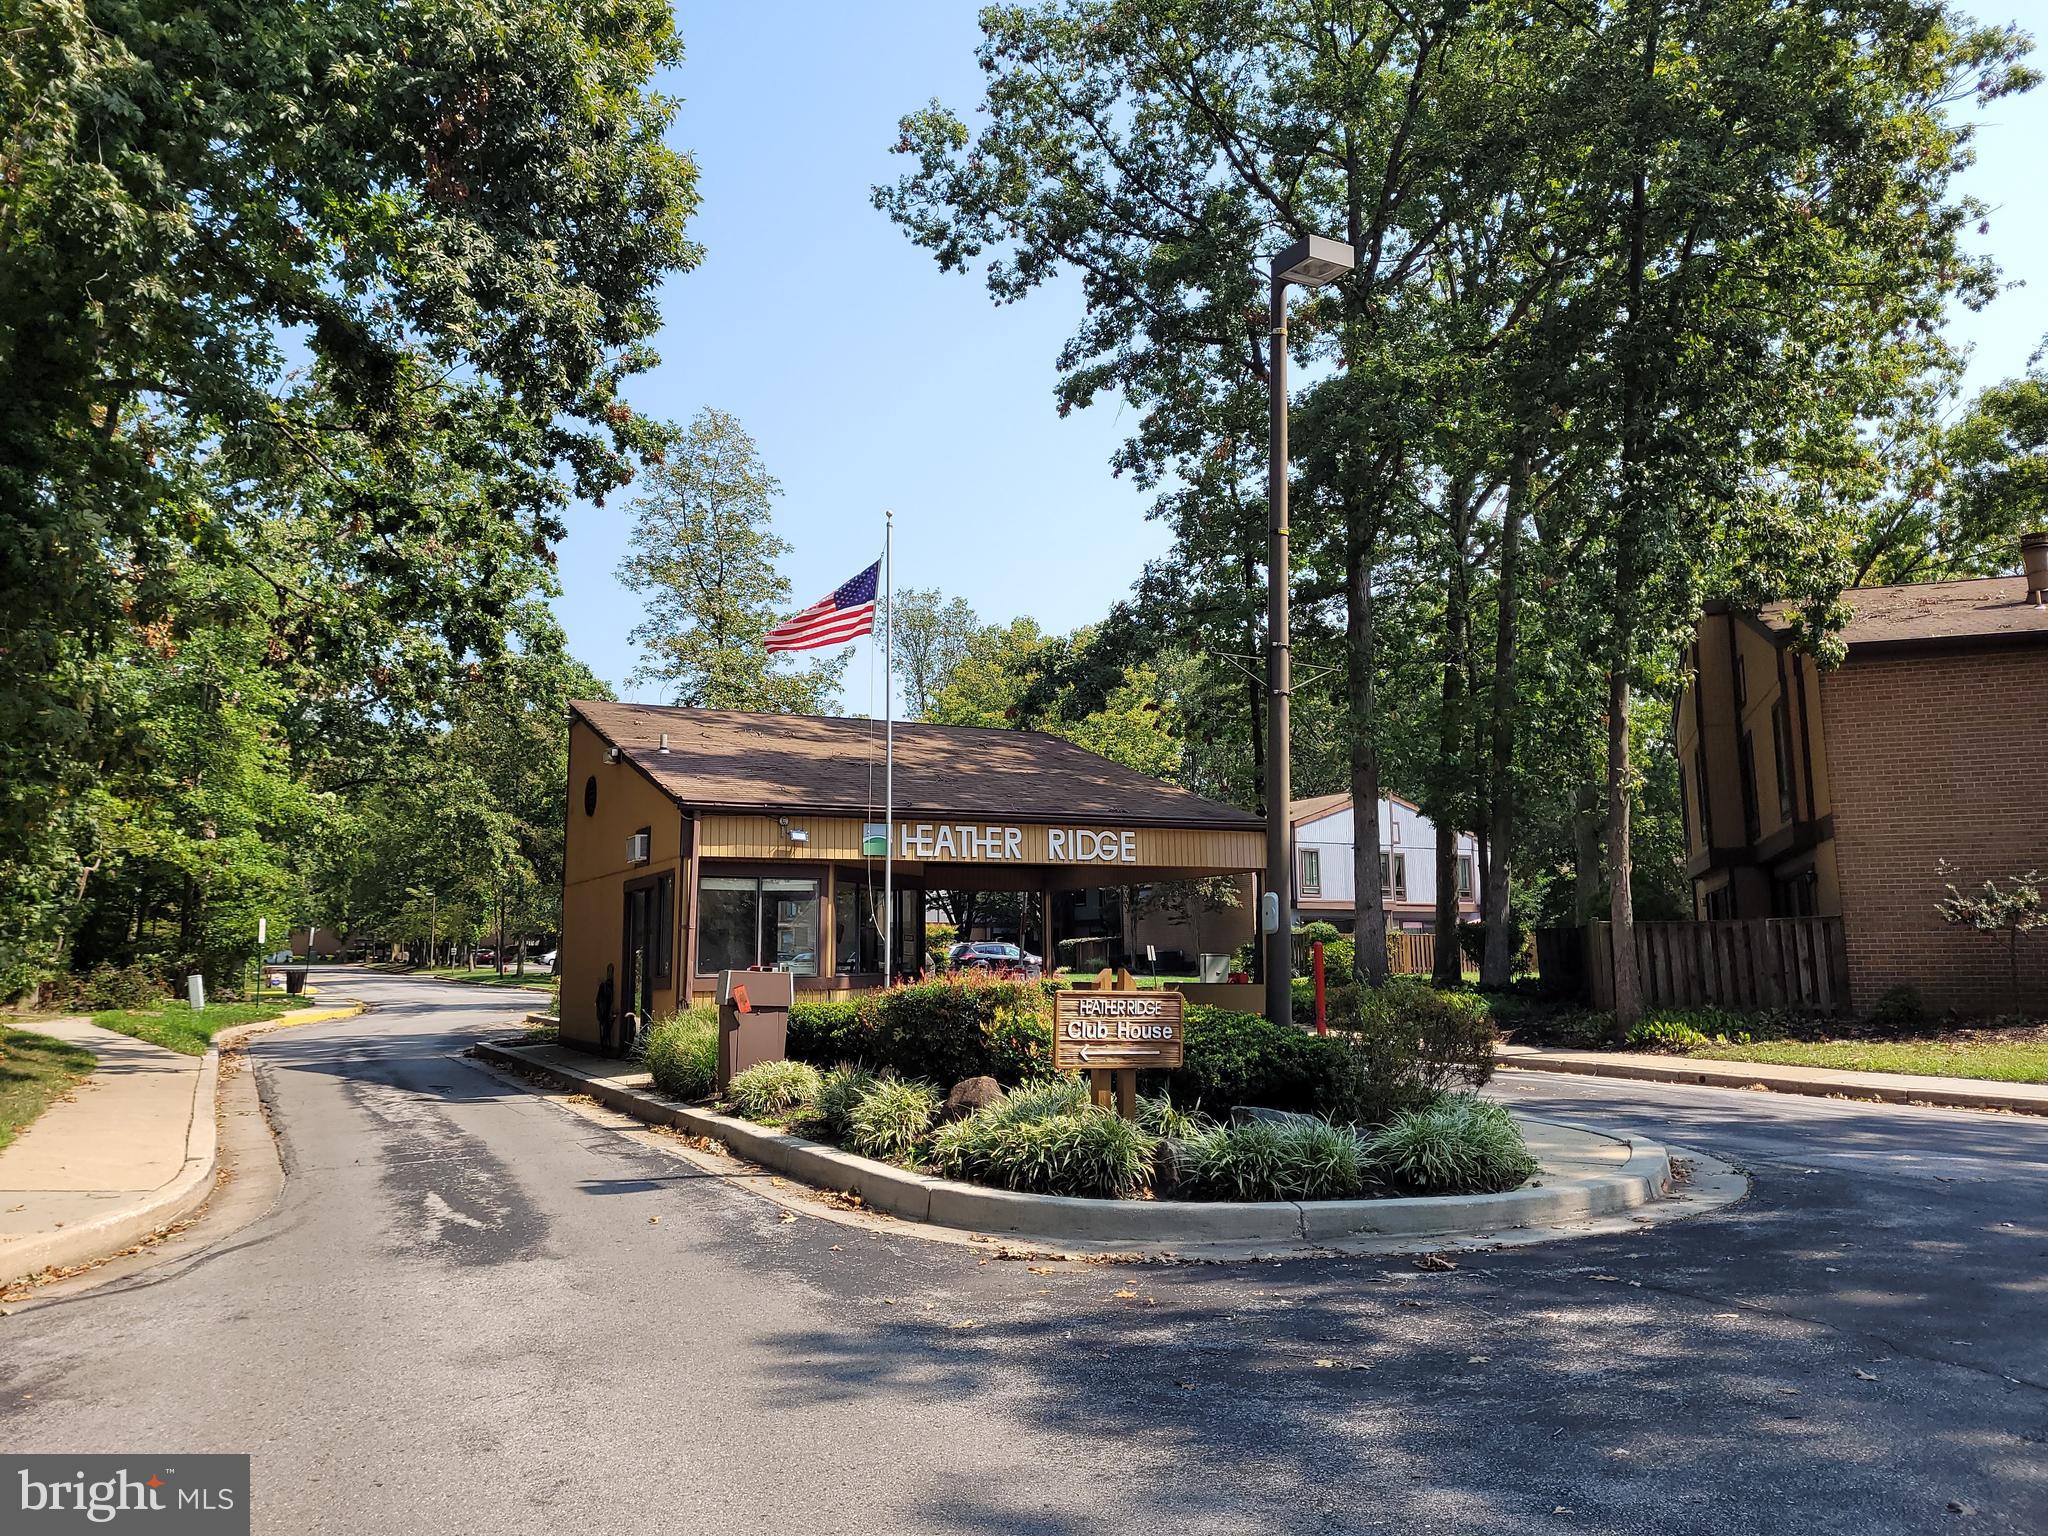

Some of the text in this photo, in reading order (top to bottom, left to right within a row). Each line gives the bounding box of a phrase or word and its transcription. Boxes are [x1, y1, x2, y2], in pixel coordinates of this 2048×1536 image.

[901, 823, 1136, 862] HEATHER RIDGE
[1080, 1000, 1162, 1015] HEATHER RIDGE
[1067, 1021, 1173, 1039] Club House
